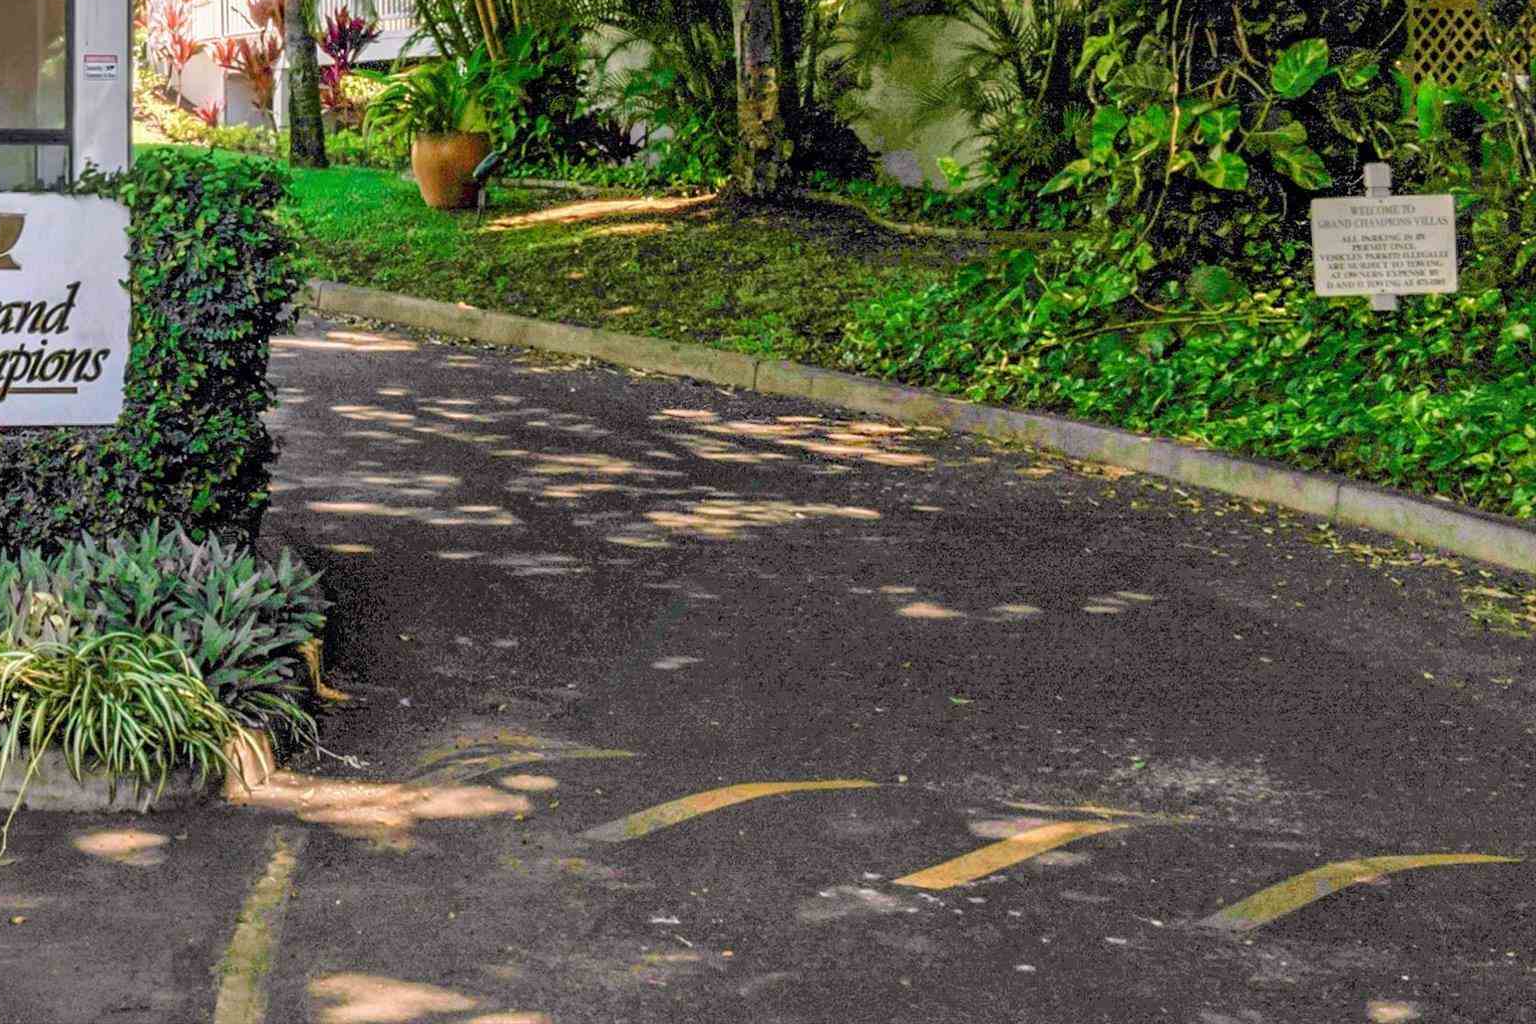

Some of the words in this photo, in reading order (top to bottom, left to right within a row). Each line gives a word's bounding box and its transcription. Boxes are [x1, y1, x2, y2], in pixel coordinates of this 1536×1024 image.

[1350, 206, 1399, 216] WELCOME
[1402, 205, 1416, 214] TO
[1318, 219, 1352, 228] GRAND
[1354, 218, 1412, 228] CHAMPIONS
[1415, 216, 1448, 225] VILLAS
